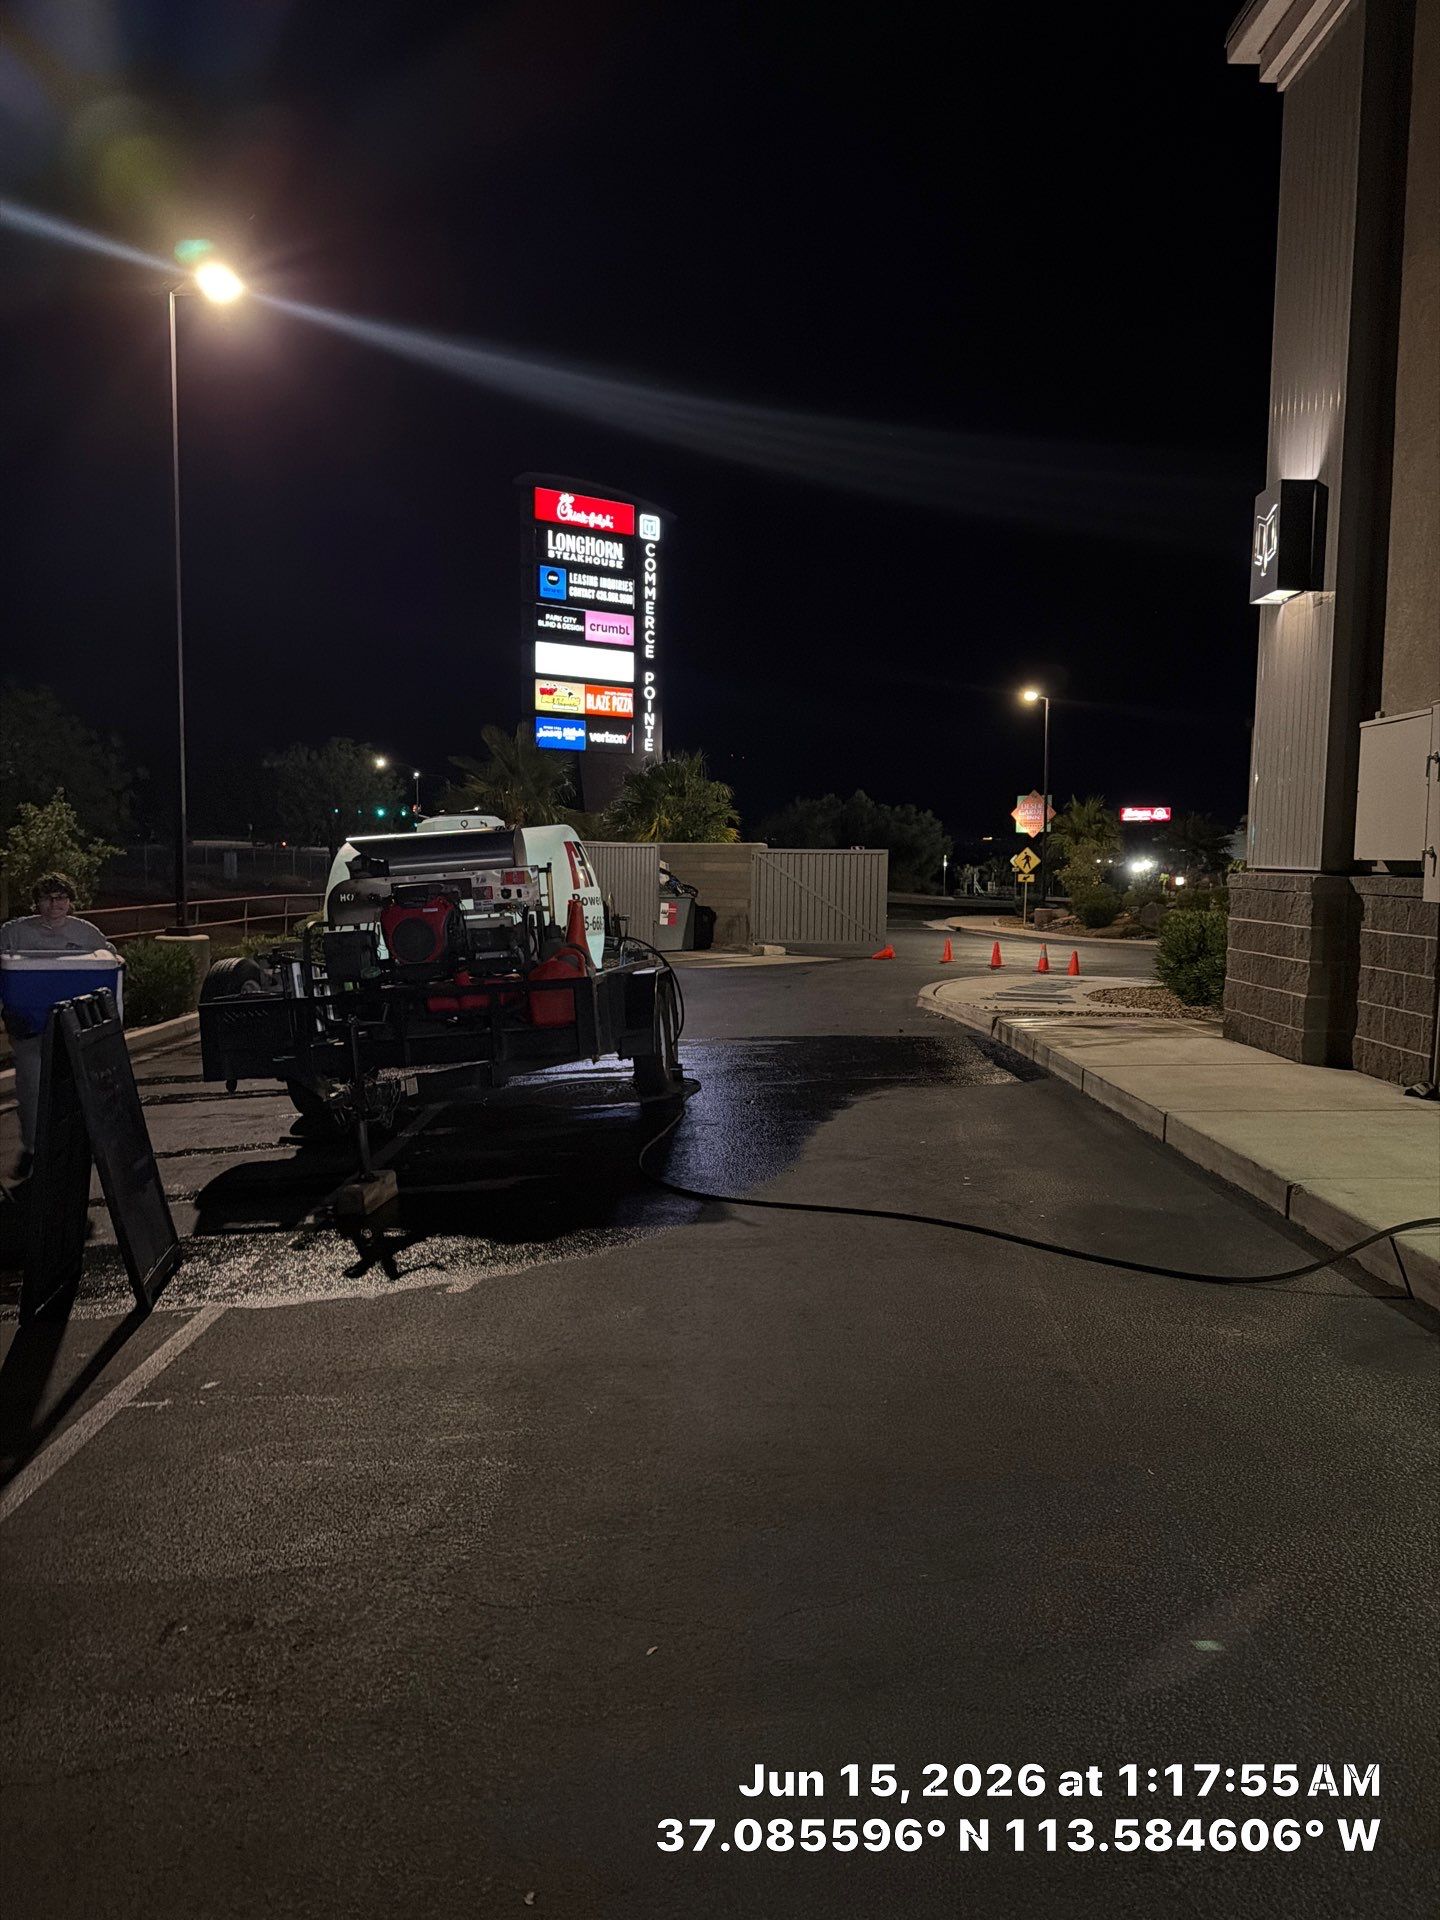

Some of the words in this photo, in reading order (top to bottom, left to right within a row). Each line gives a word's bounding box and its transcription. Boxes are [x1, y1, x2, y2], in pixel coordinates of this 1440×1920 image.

[547, 529, 625, 561] LONGHORN
[547, 549, 624, 570] STEAKHOUSE
[569, 572, 599, 588] LEASING
[644, 543, 657, 659] COMMERCE
[545, 613, 563, 623] PARK
[563, 616, 578, 624] CITY
[562, 623, 585, 632] DESIGN
[589, 623, 631, 636] crumbl
[586, 693, 612, 711] BLAZE
[612, 696, 633, 713] PIZZA
[643, 672, 656, 752] POINTE
[588, 731, 628, 745] verizon
